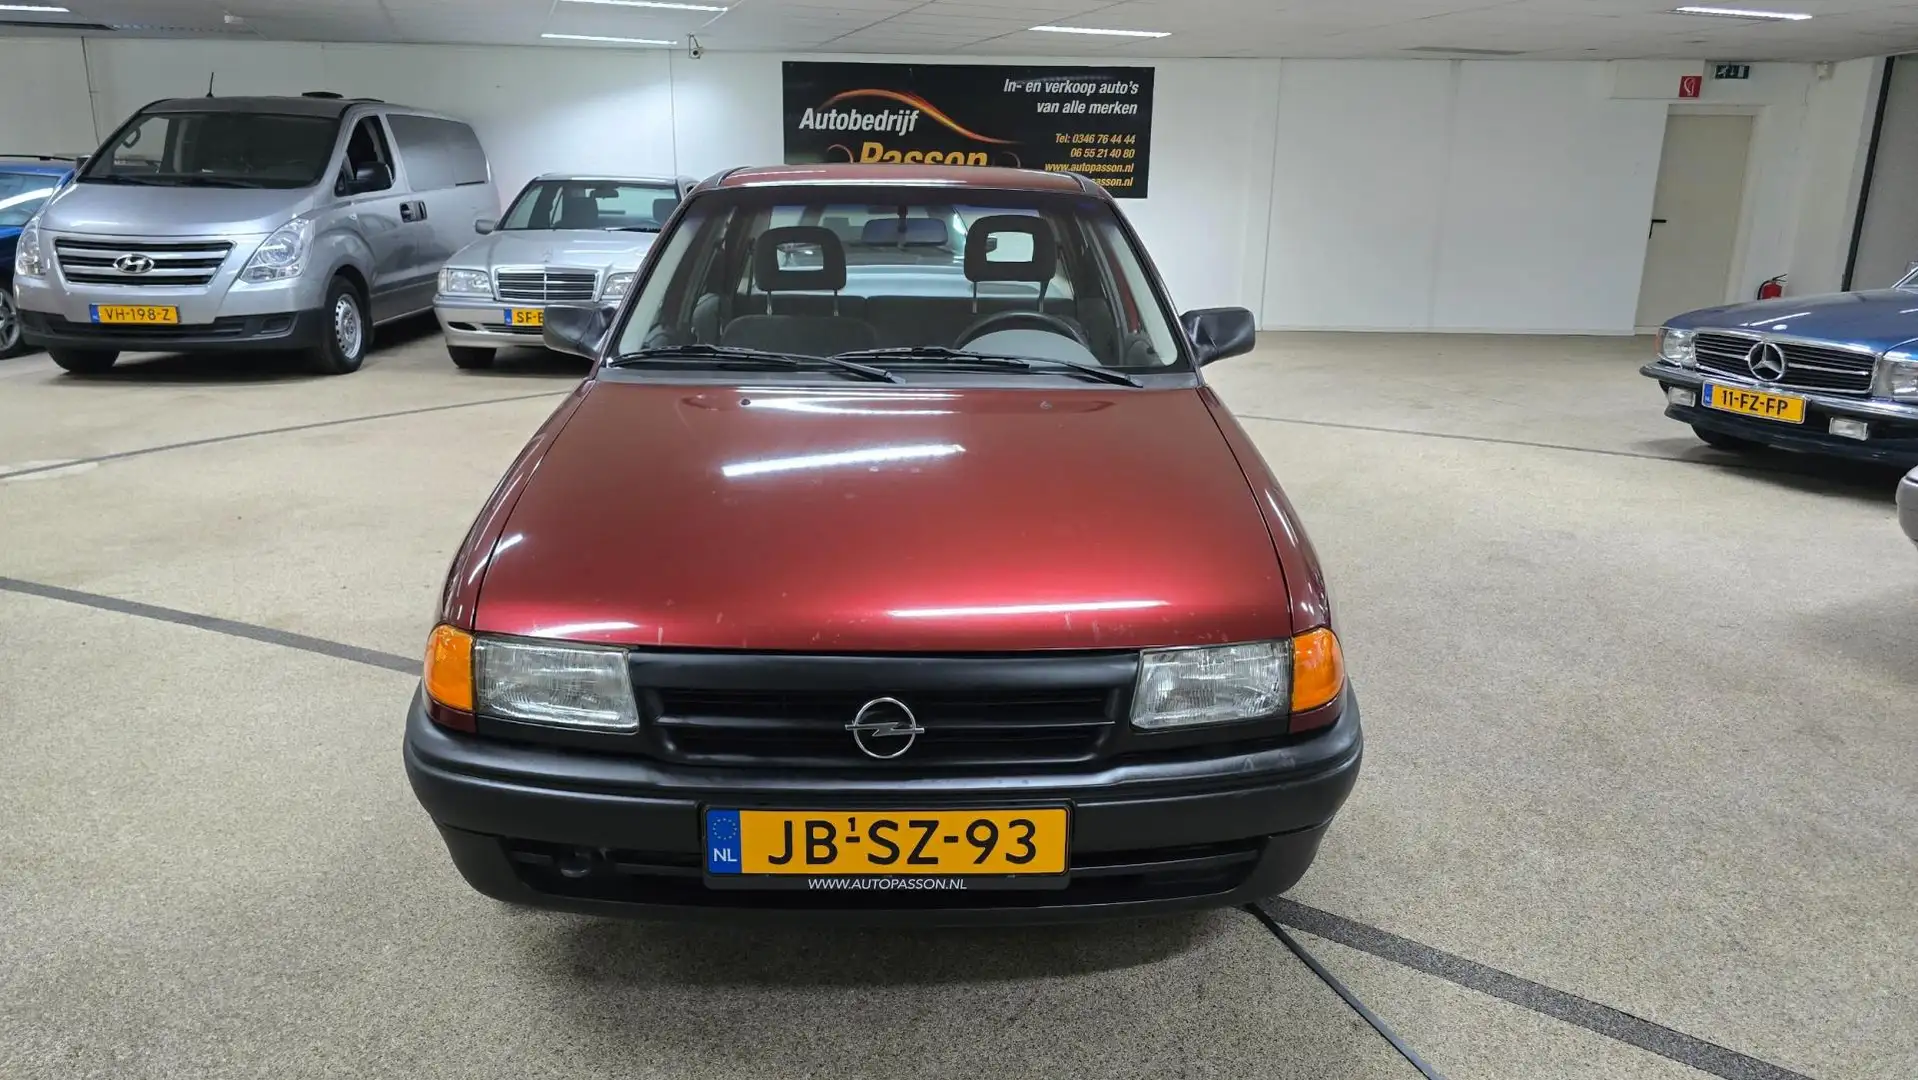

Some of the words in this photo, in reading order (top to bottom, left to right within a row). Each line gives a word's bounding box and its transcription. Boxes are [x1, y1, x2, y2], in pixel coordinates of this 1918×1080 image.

[1003, 79, 1022, 92] In-
[1025, 82, 1041, 93] en
[1045, 80, 1096, 96] verkoop
[1099, 80, 1139, 95] auto's
[1037, 102, 1060, 113] van
[1062, 100, 1086, 114] alle
[1088, 101, 1138, 115] merken
[799, 108, 919, 136] Autobedrijf
[1055, 133, 1070, 144] Tel:
[1072, 134, 1095, 144] 0346
[1097, 134, 1109, 144] 76
[1110, 134, 1122, 144] 44
[1123, 134, 1136, 145] 44
[1070, 148, 1082, 158] 06
[1083, 148, 1096, 158] 55
[1097, 148, 1108, 158] 21
[1109, 148, 1121, 159] 40
[1123, 148, 1136, 159] 80
[1044, 162, 1135, 173] www.autopasson.nl
[1091, 177, 1134, 187] asson.nl
[104, 307, 171, 321] VH-198-Z
[1722, 390, 1788, 415] 11-FZ-FP
[713, 848, 737, 862] NL
[807, 878, 968, 890] WWW.AUTOPASSON.NL
